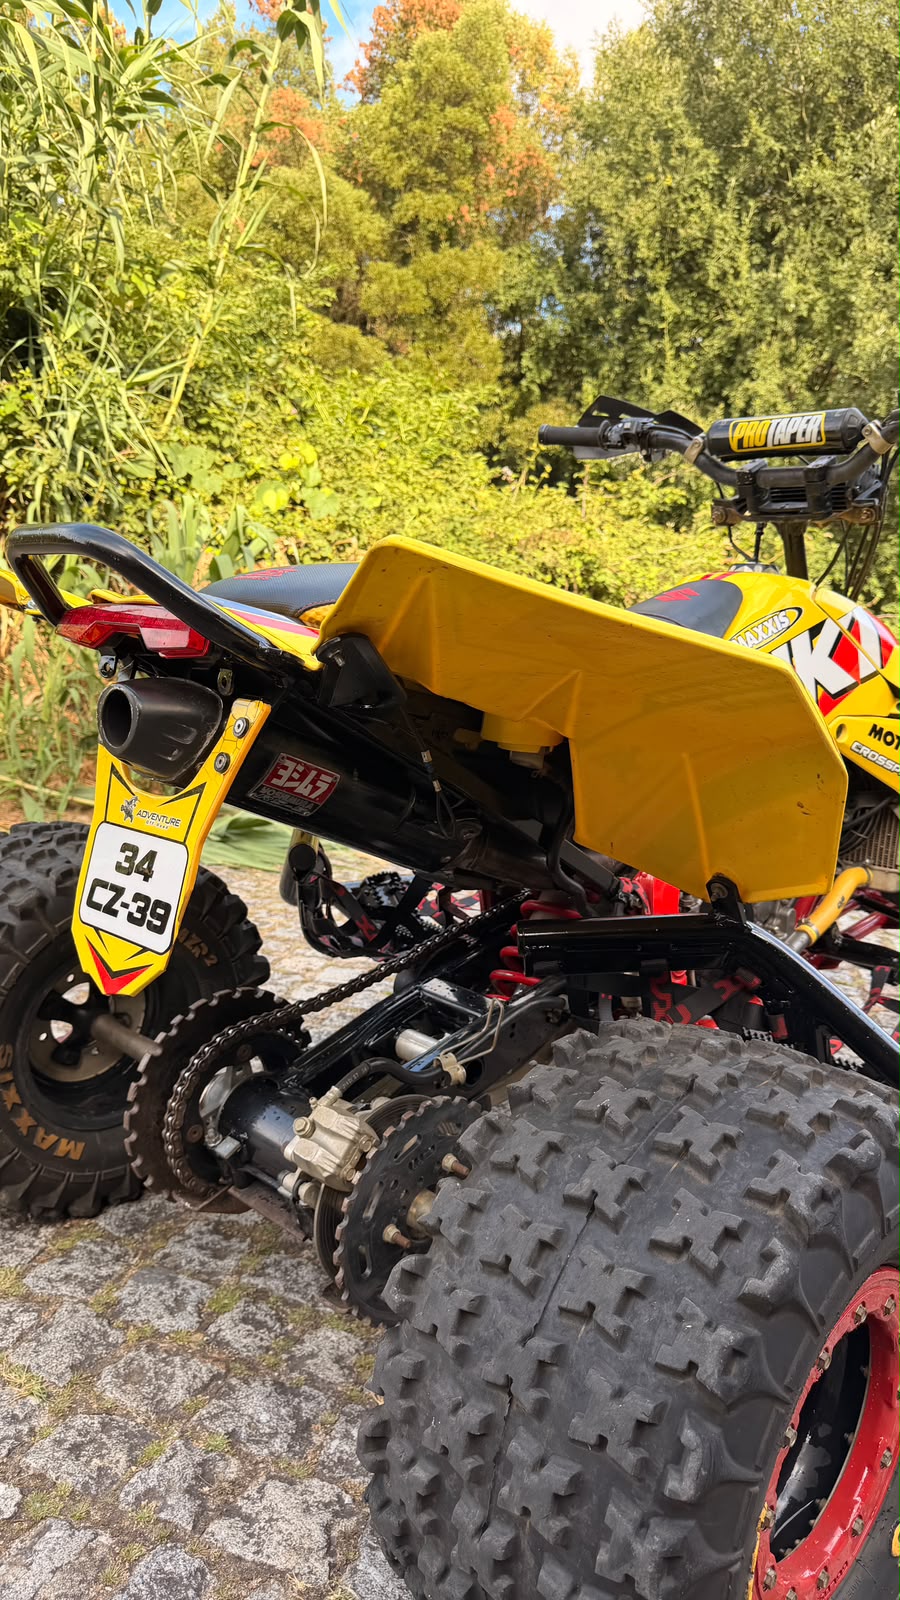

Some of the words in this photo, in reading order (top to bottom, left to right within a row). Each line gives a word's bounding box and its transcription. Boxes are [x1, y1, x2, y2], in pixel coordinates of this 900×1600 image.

[136, 809, 182, 828] ADVENTURE
[115, 842, 158, 883] 34
[86, 877, 172, 936] CZ-39
